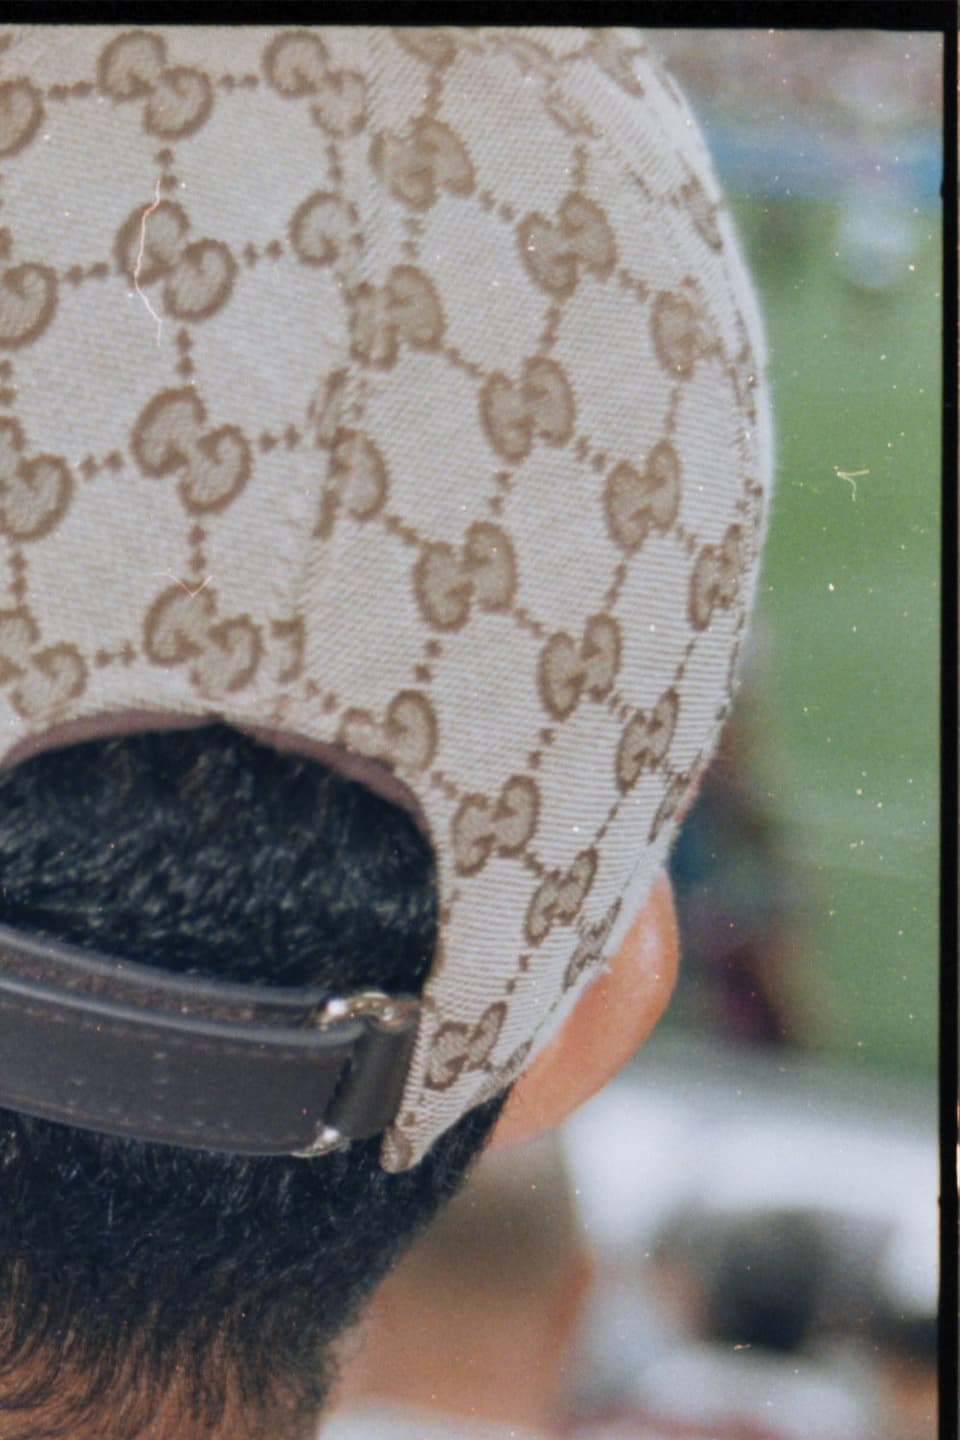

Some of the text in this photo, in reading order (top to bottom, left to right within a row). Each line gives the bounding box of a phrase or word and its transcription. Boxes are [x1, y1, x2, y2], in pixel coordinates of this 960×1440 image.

[96, 30, 213, 139] GG
[114, 200, 238, 322] GG
[517, 191, 617, 298] GG
[129, 385, 253, 515] GG
[479, 355, 575, 459] GG
[605, 440, 680, 549] GG
[413, 522, 517, 631] GG
[143, 582, 261, 694] GG
[540, 613, 621, 720] GG
[617, 689, 679, 795] GG
[453, 776, 539, 877] GG
